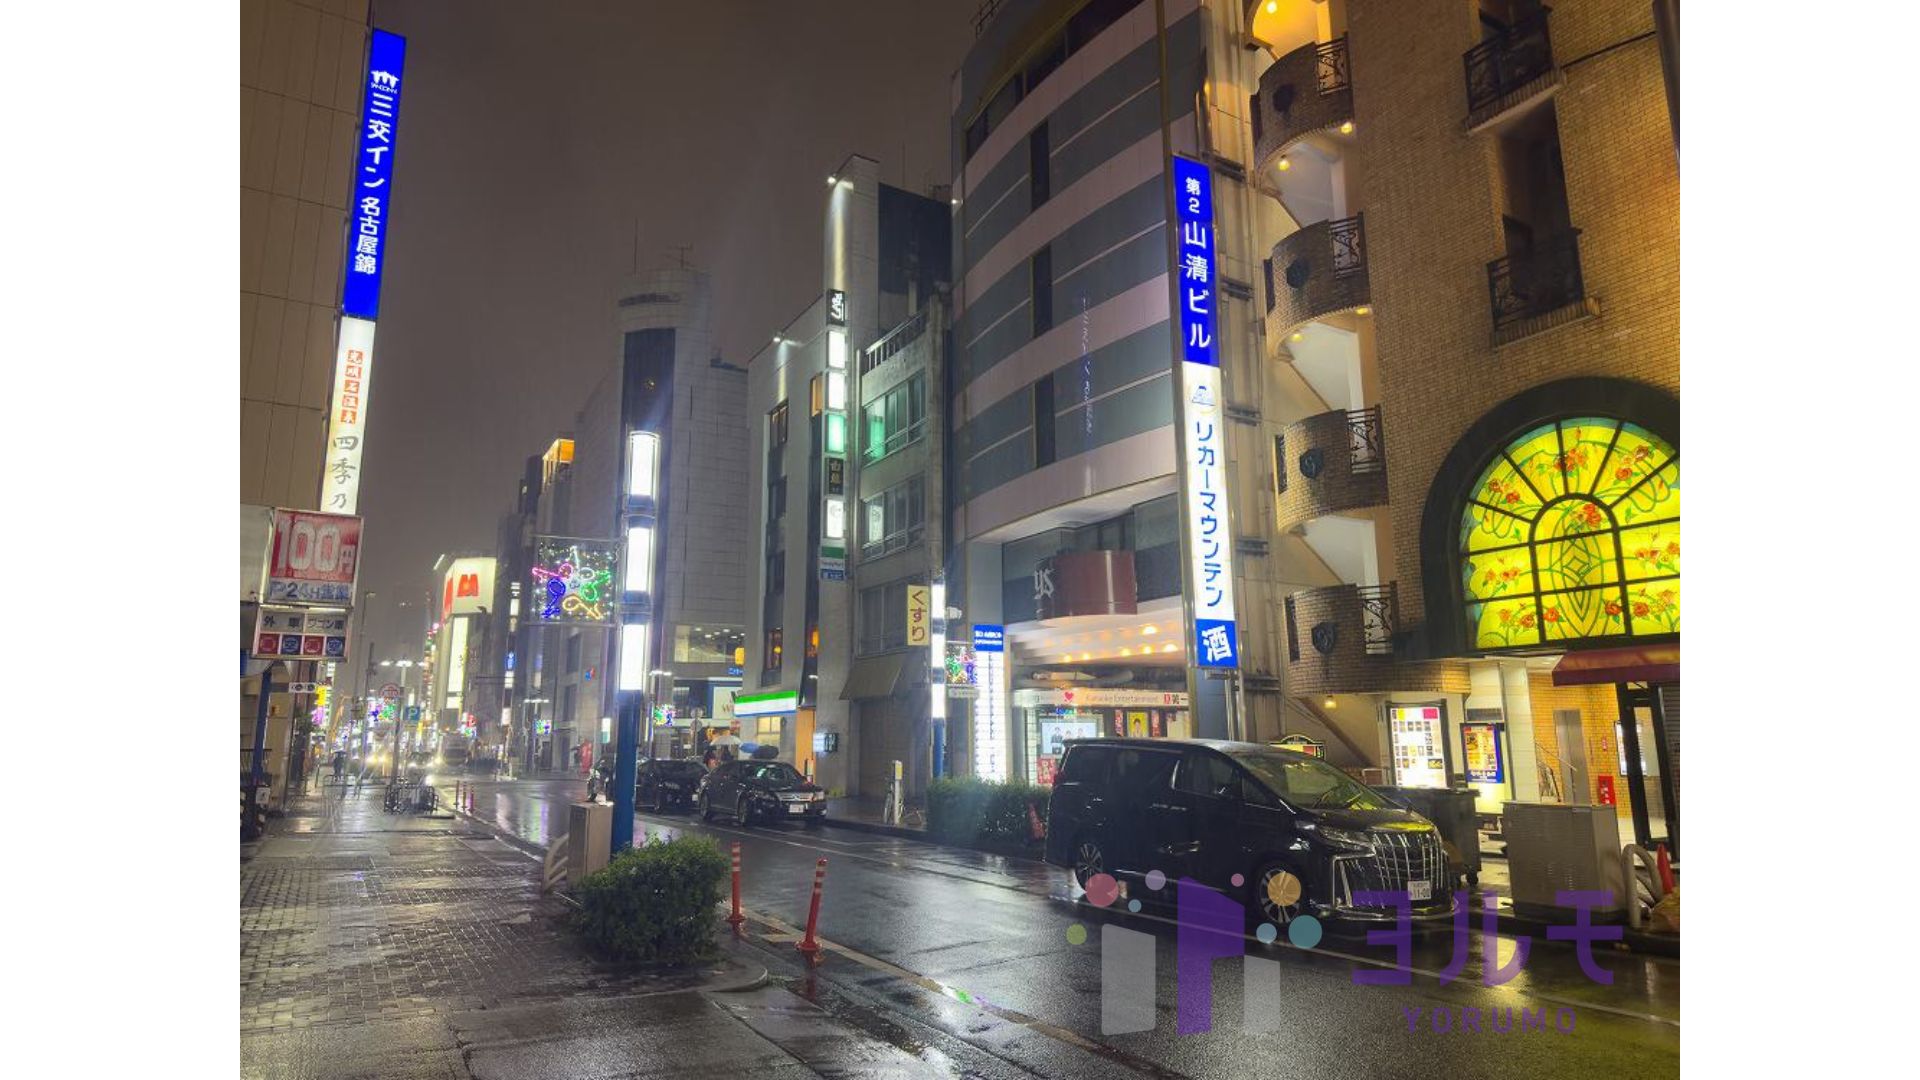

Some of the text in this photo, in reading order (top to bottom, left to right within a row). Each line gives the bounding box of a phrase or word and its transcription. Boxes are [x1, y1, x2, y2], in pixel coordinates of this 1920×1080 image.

[354, 93, 393, 274] 三交イン 名古屋錦
[1196, 421, 1223, 607] リカーマウンテン
[910, 590, 927, 642] くすり
[1201, 625, 1233, 664] 酒
